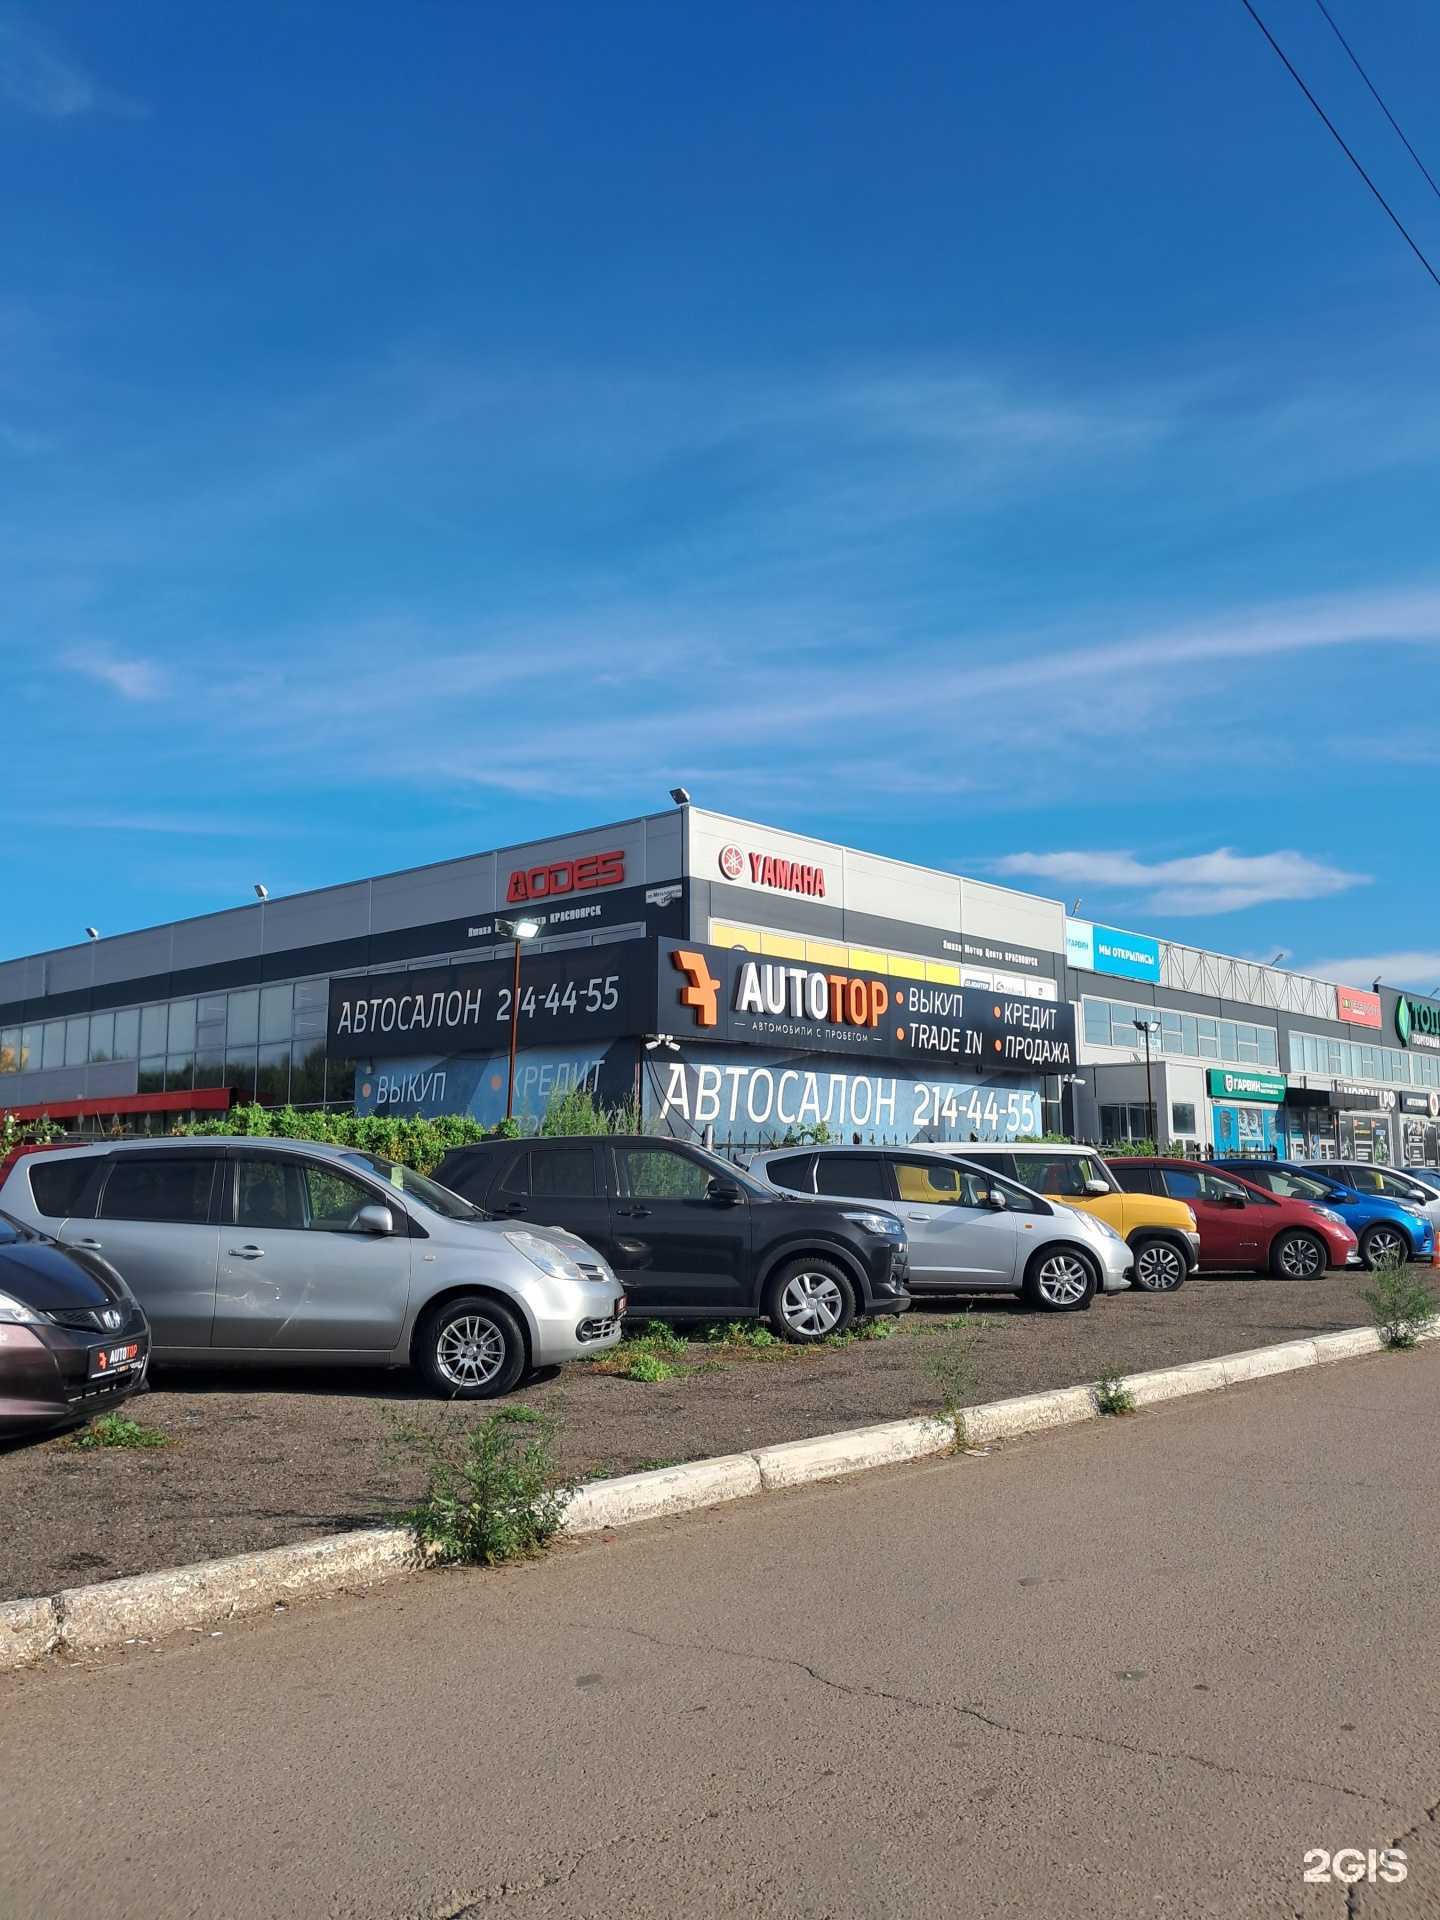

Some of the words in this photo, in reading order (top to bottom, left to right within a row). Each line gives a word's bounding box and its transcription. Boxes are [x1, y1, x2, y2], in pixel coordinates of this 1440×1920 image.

[749, 852, 826, 897] YAMAHA
[549, 905, 602, 924] КРАСНОЯРСК
[735, 962, 889, 1028] AUTOTOP
[908, 987, 963, 1018] ВЫКУП
[337, 988, 482, 1034] АВТОСАЛОН
[1004, 1002, 1057, 1031] КРЕДИТ
[752, 1021, 813, 1037] АВТОМОБИЛИ
[825, 1029, 869, 1042] ПРОБЕГОМ
[909, 1023, 961, 1054] TRADE
[964, 1030, 983, 1055] IN
[1005, 1036, 1071, 1064] ПРОДАЖА
[377, 1072, 447, 1104] ВЫКУП
[660, 1063, 897, 1126] АВТОСАЛОН
[913, 1083, 1035, 1133] 214-44-55
[109, 1344, 138, 1364] AUTOTOP
